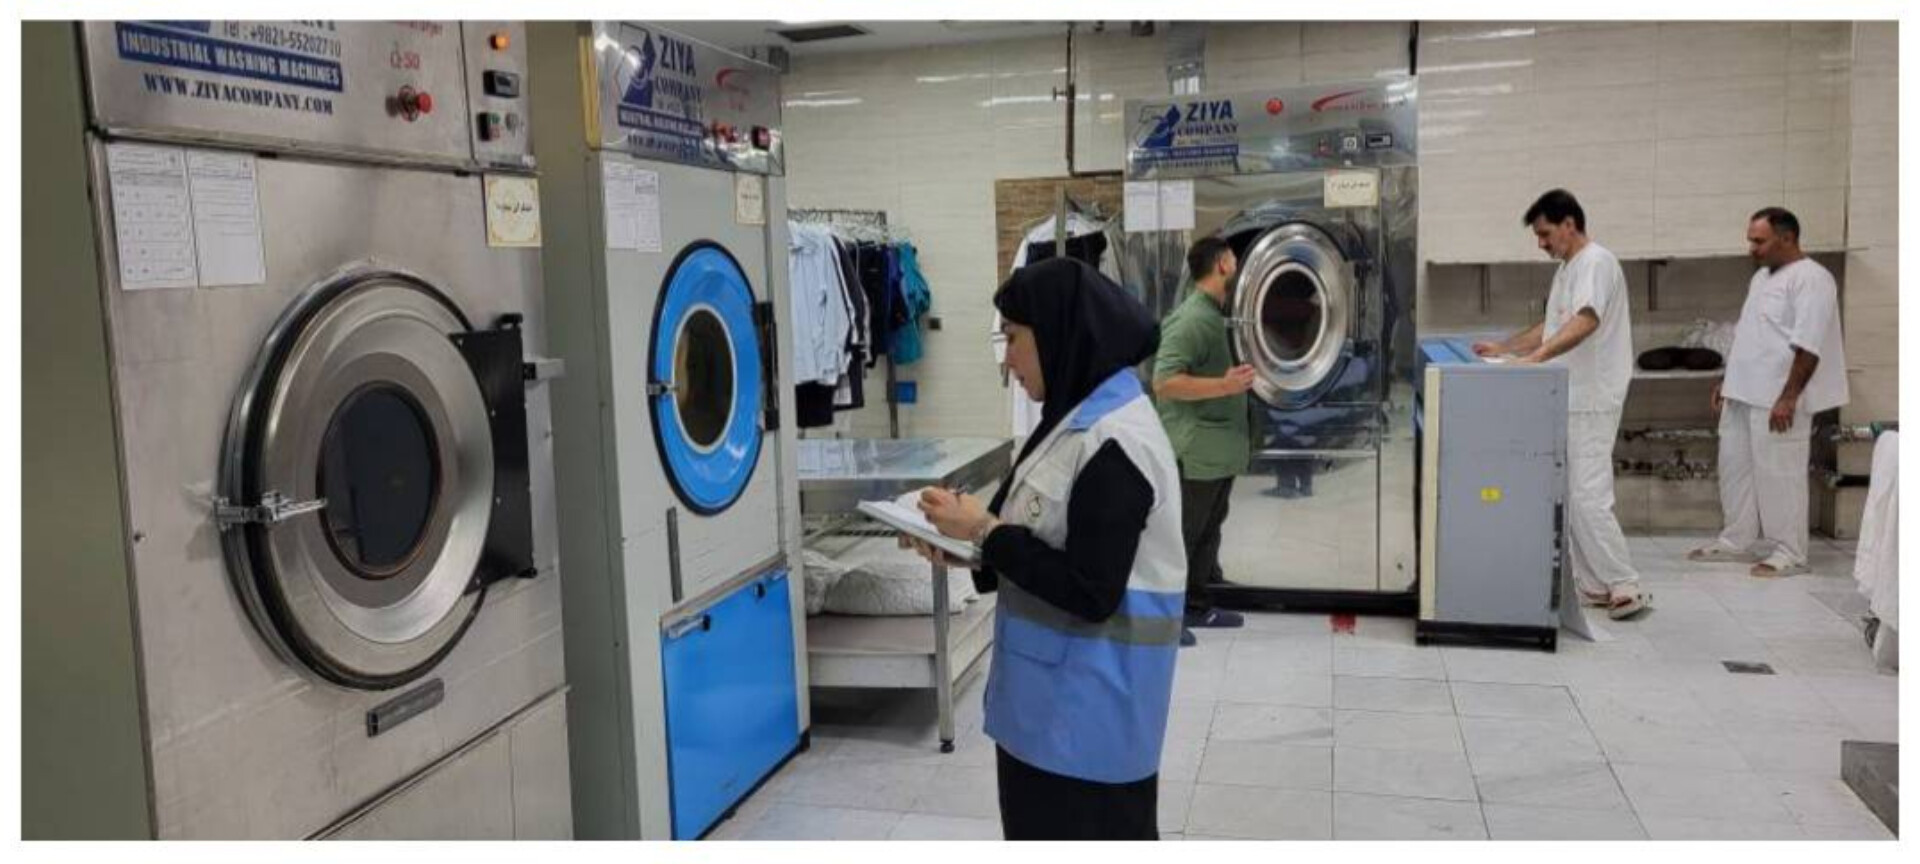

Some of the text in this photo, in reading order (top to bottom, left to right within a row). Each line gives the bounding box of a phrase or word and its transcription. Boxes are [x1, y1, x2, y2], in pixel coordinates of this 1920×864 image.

[122, 29, 341, 86] INDUSTRIAL WASHING MACHINES
[659, 34, 697, 77] ZIYA
[143, 73, 334, 115] WWW.ZIYACOMPANY.COM
[1186, 99, 1233, 121] ZIYA
